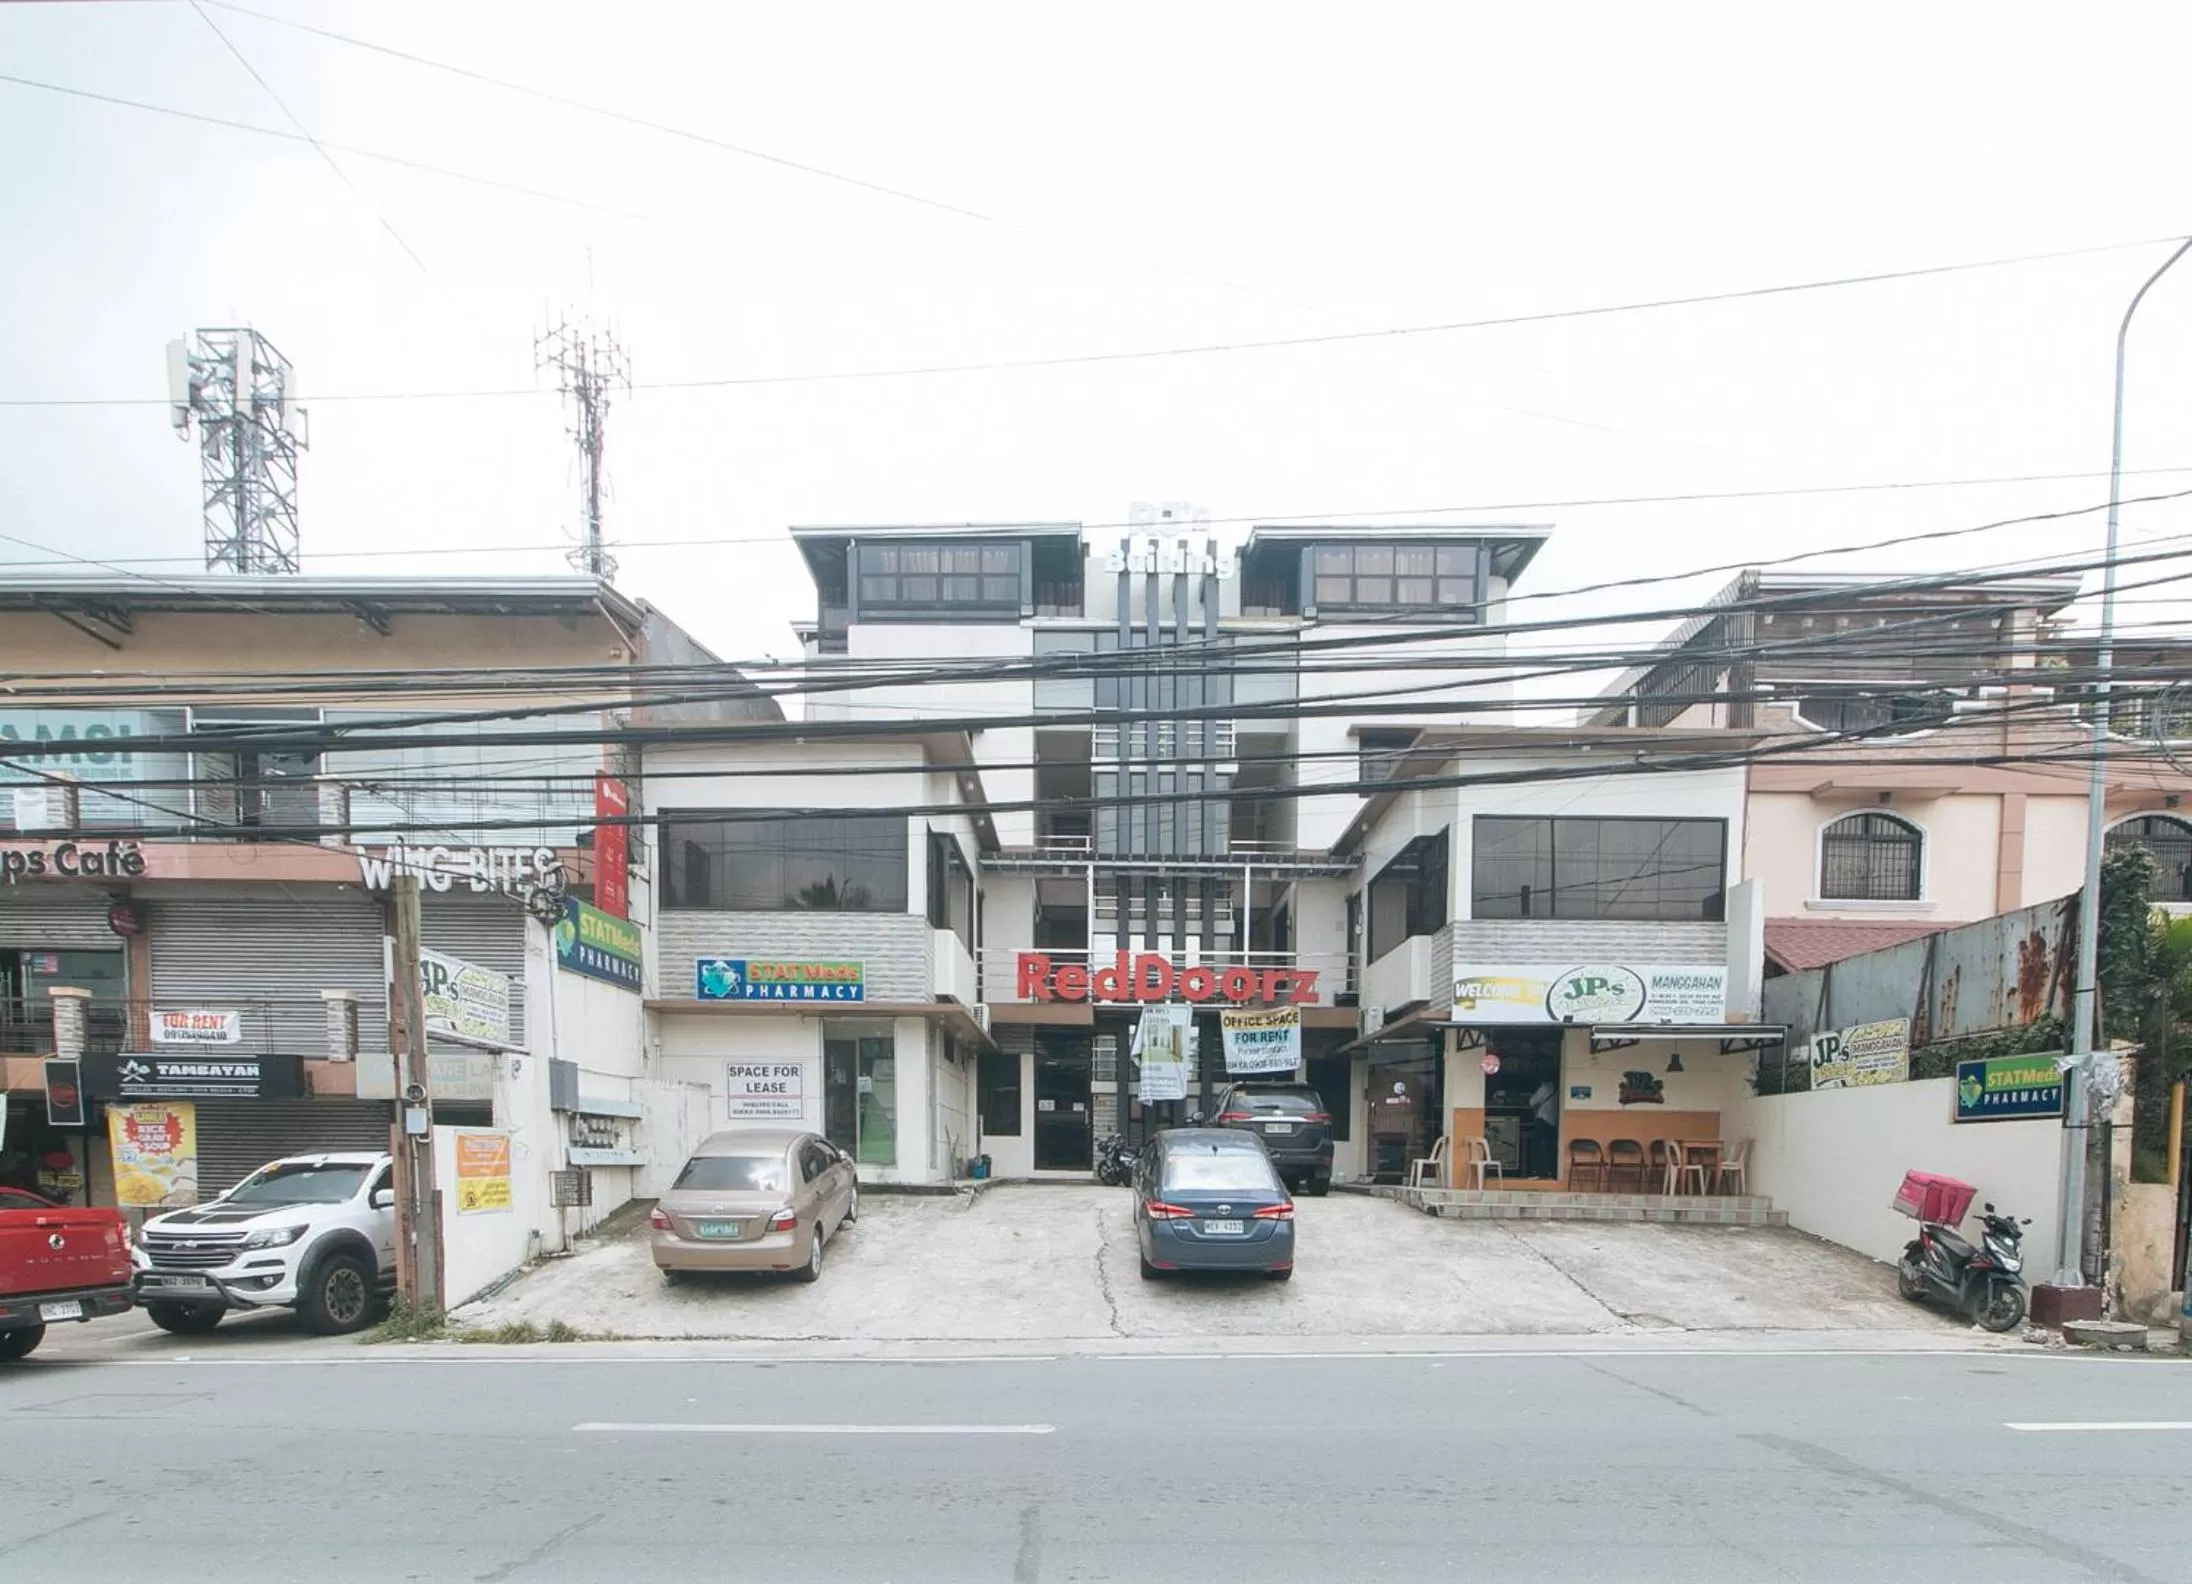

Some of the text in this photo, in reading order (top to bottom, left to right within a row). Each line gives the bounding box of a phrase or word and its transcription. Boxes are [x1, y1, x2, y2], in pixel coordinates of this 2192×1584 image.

[54, 841, 145, 876] Café
[580, 945, 640, 982] PHARMACY
[1017, 950, 1320, 1003] RedDoorz
[746, 984, 858, 999] PHARMACY
[163, 1013, 227, 1029] FOR RENT
[1223, 1011, 1299, 1027] OFFICE SPACE
[1235, 1029, 1290, 1044] FOR RENT
[156, 1065, 260, 1077] TAMBAYAN
[729, 1066, 799, 1078] SPACE FOR
[1987, 1066, 2061, 1089] STATMeds
[746, 1082, 787, 1093] LEASE
[1983, 1088, 2058, 1105] PHARMACY
